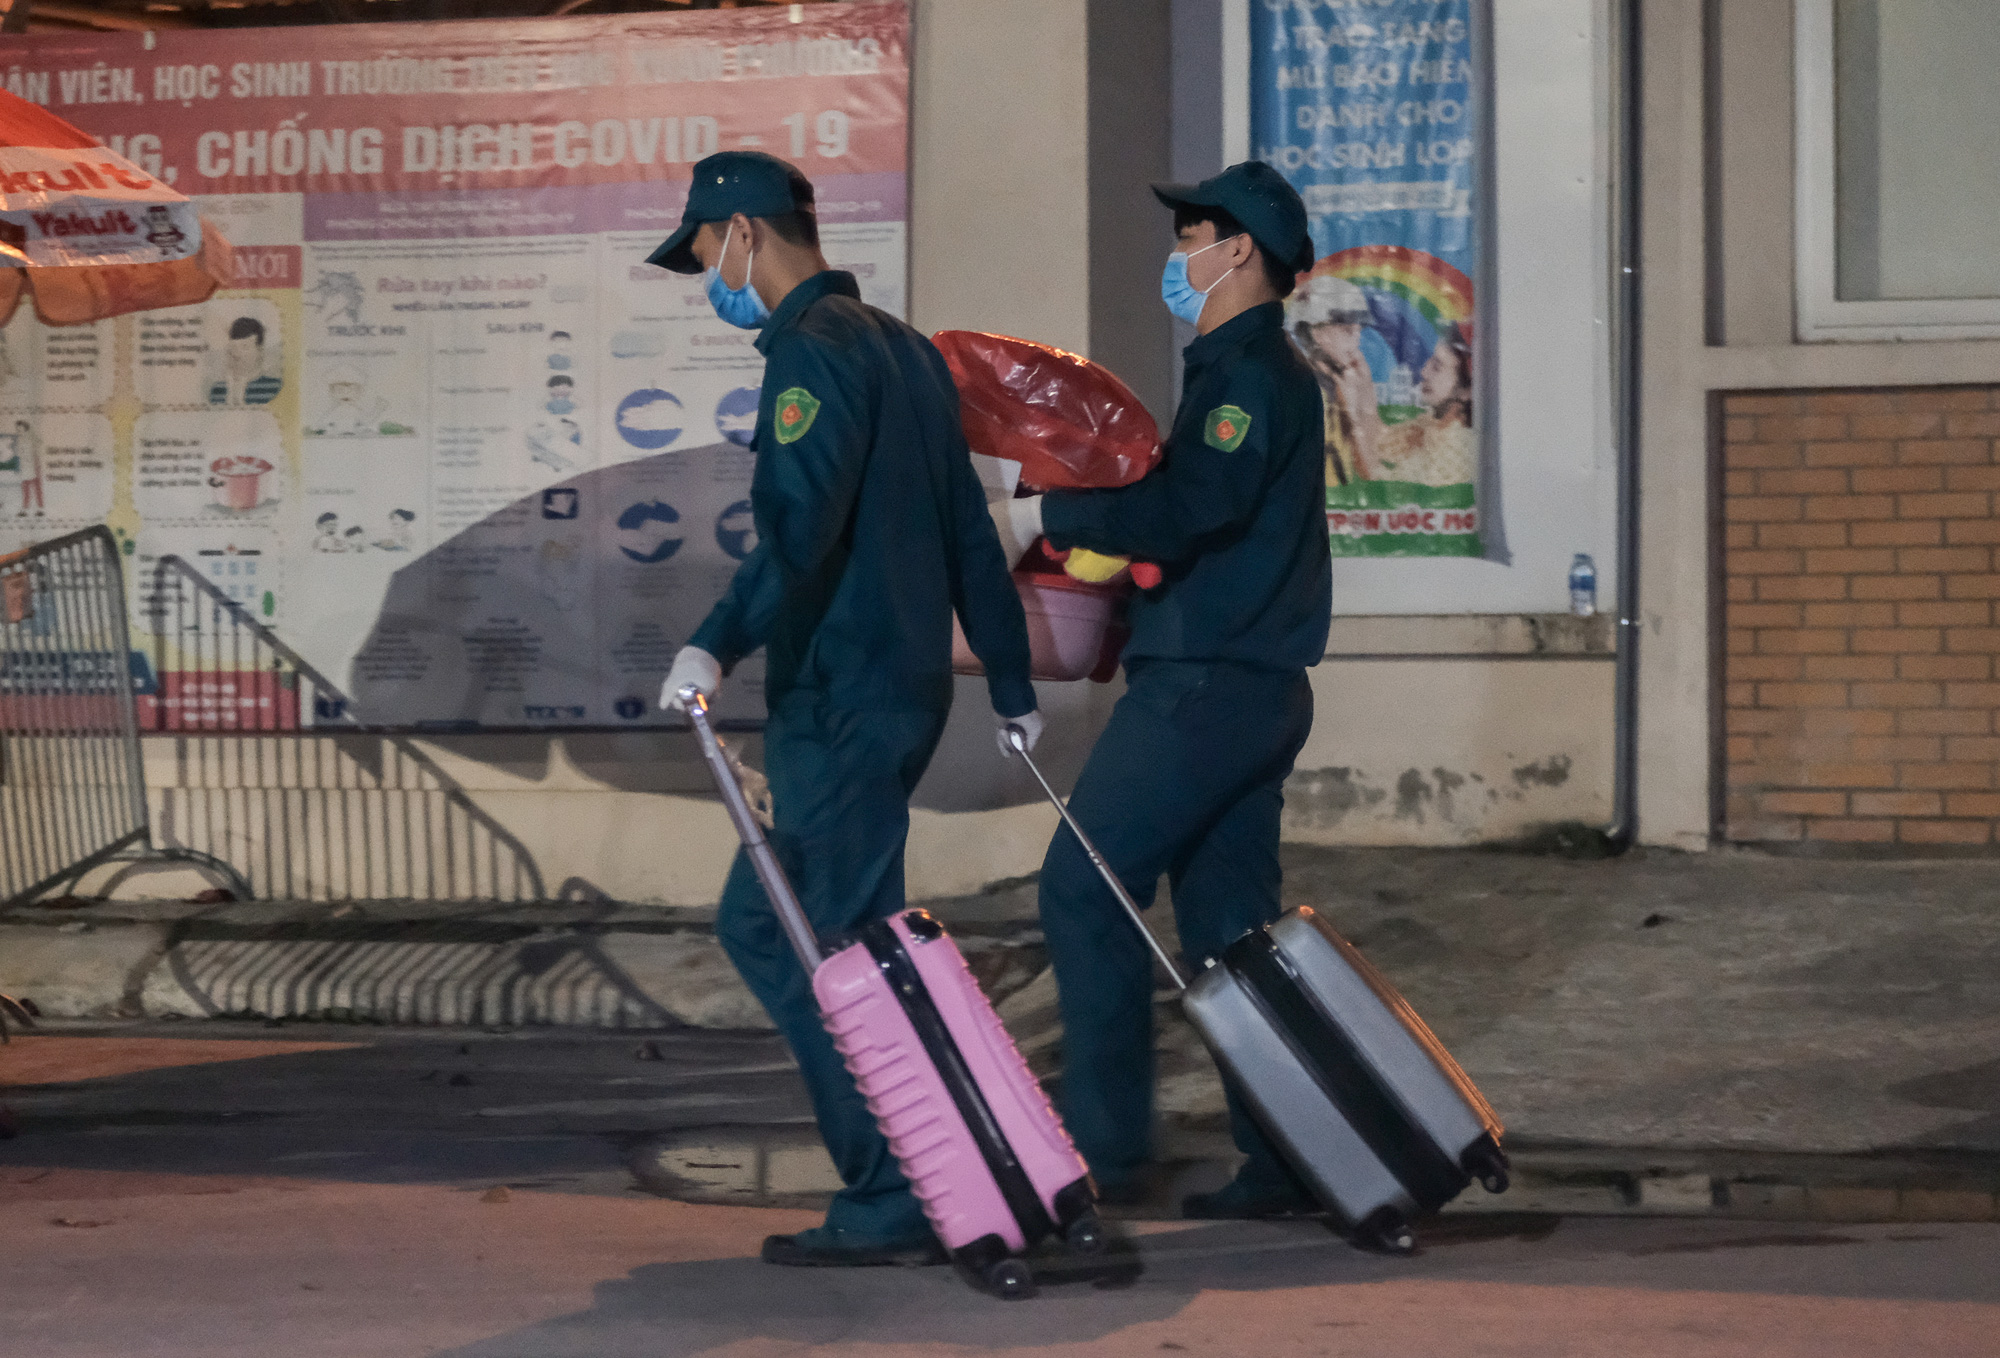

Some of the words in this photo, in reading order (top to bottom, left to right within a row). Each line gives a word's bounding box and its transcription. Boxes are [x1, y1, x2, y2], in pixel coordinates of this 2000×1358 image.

[59, 61, 144, 105] VIÊN,
[154, 64, 220, 108] HỌC
[230, 62, 311, 97] SINH
[197, 112, 383, 178] CHỐNG
[553, 114, 719, 168] COVID
[781, 109, 850, 159] 19
[31, 209, 138, 237] Yakult
